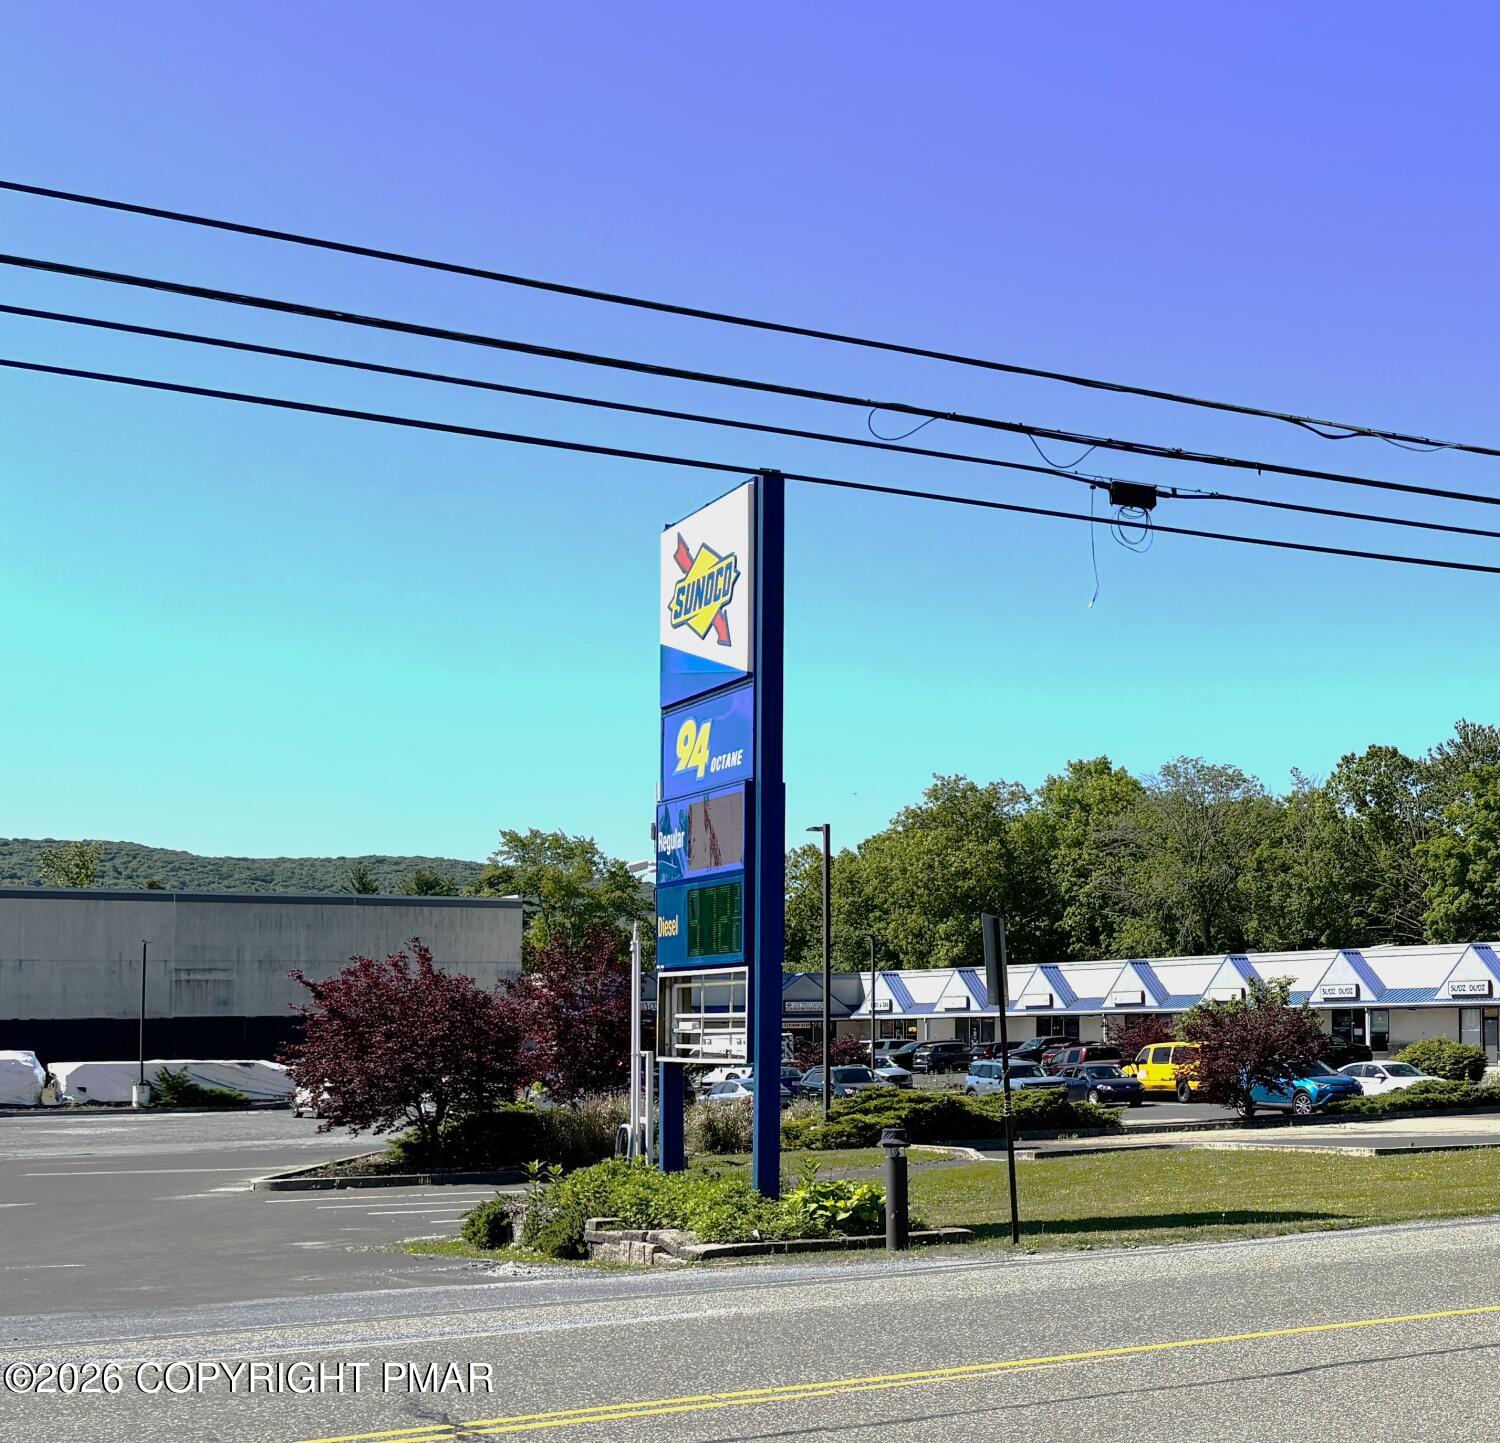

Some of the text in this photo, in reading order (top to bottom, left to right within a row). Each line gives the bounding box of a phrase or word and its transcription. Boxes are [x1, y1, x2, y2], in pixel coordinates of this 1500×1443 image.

[673, 561, 733, 620] SUNOCO
[674, 718, 744, 779] 94 OCTANE
[658, 828, 685, 856] Regular
[657, 914, 678, 939] Diesel
